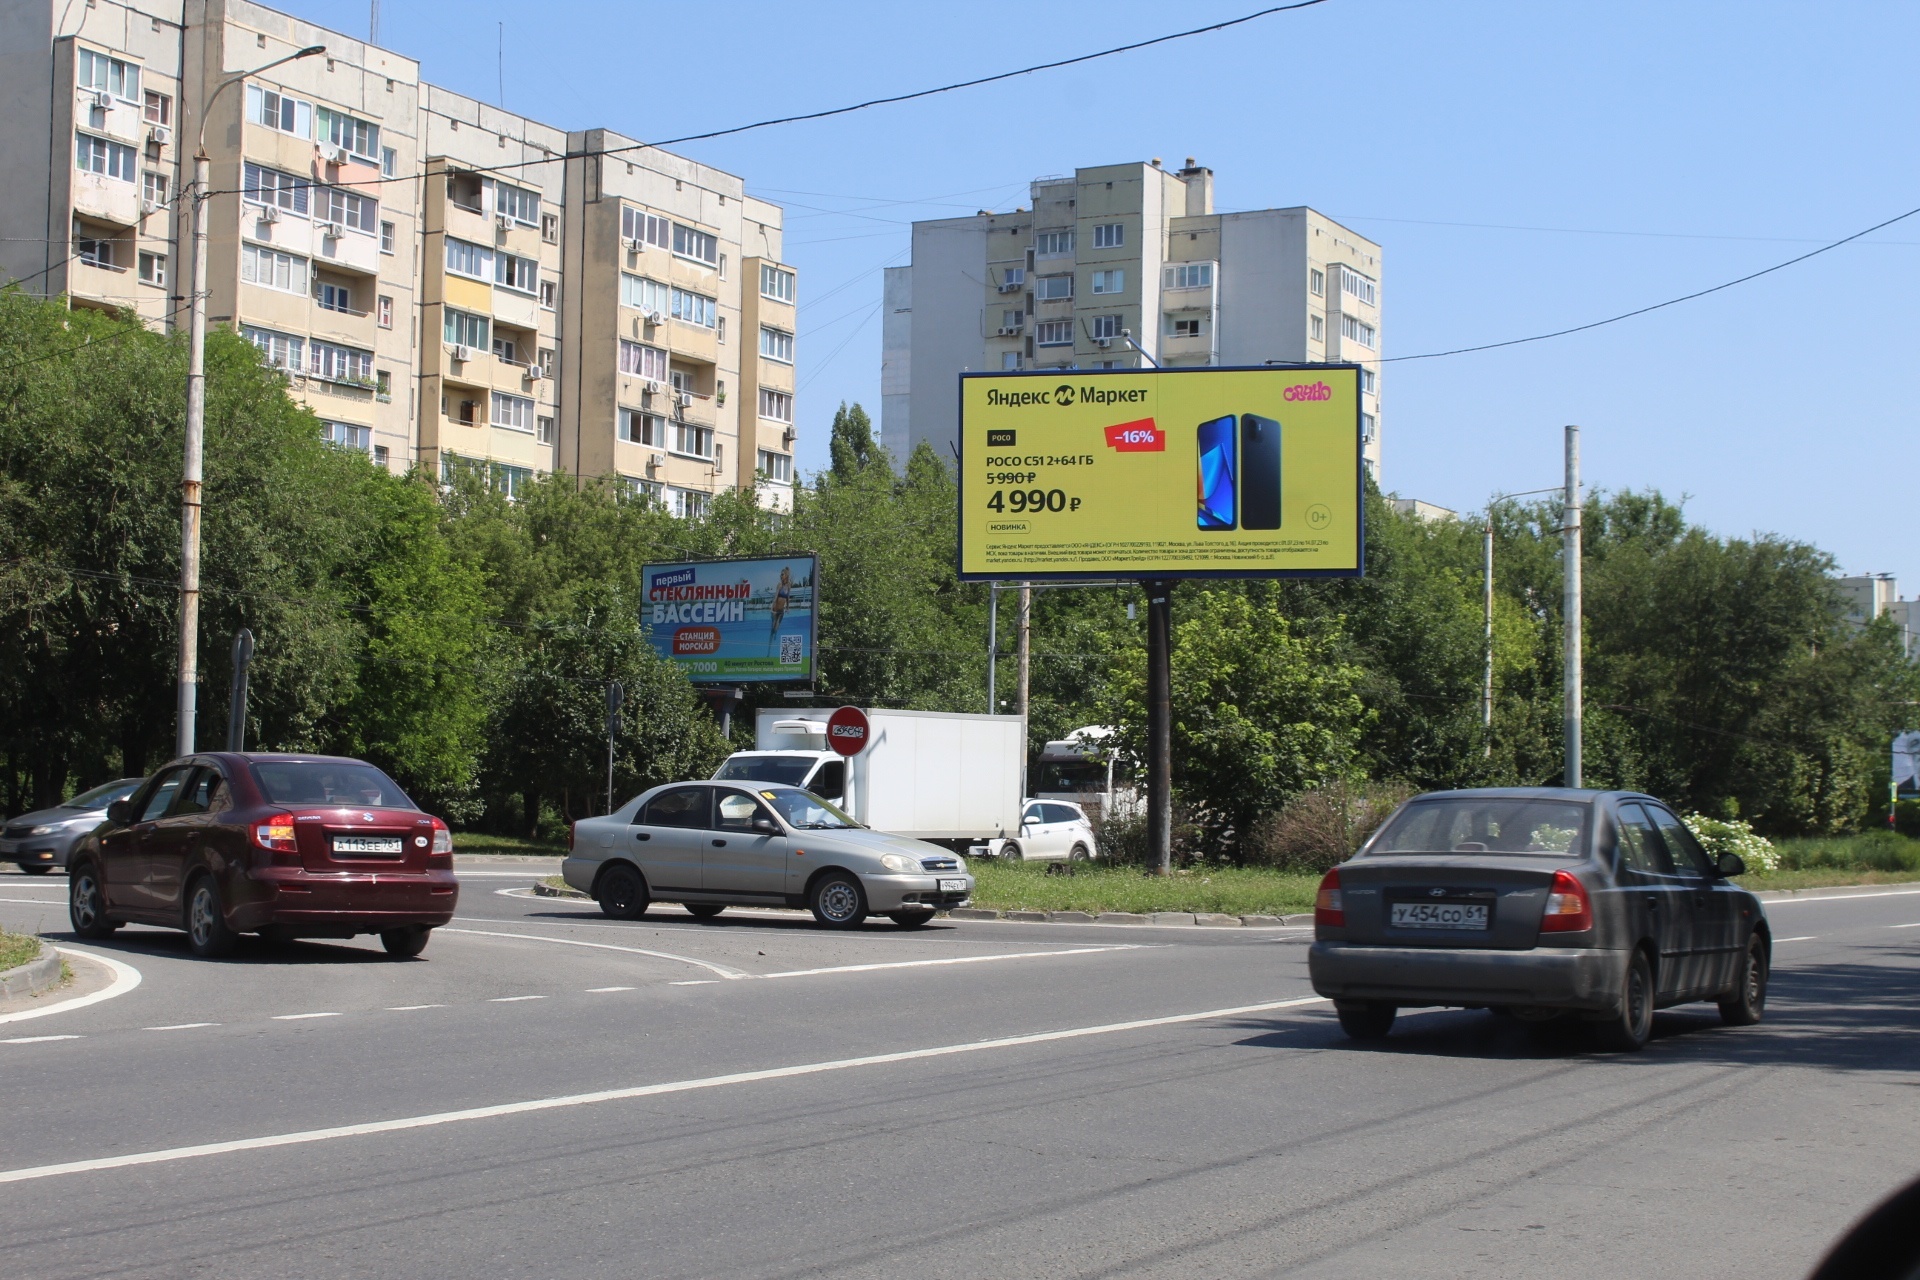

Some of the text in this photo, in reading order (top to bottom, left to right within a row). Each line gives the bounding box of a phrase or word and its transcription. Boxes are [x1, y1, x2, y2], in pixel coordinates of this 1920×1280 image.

[987, 386, 1148, 407] Яндекс Маркет
[991, 434, 1011, 442] POCO
[986, 455, 1094, 467] POCO C51 2+64 ГБ
[1311, 511, 1328, 523] 0+
[656, 571, 692, 586] первый
[649, 580, 751, 602] СТЕКЛЯННЫЙ
[653, 597, 744, 623] БАССЕЙН
[679, 632, 715, 640] СТАНЦИЯ
